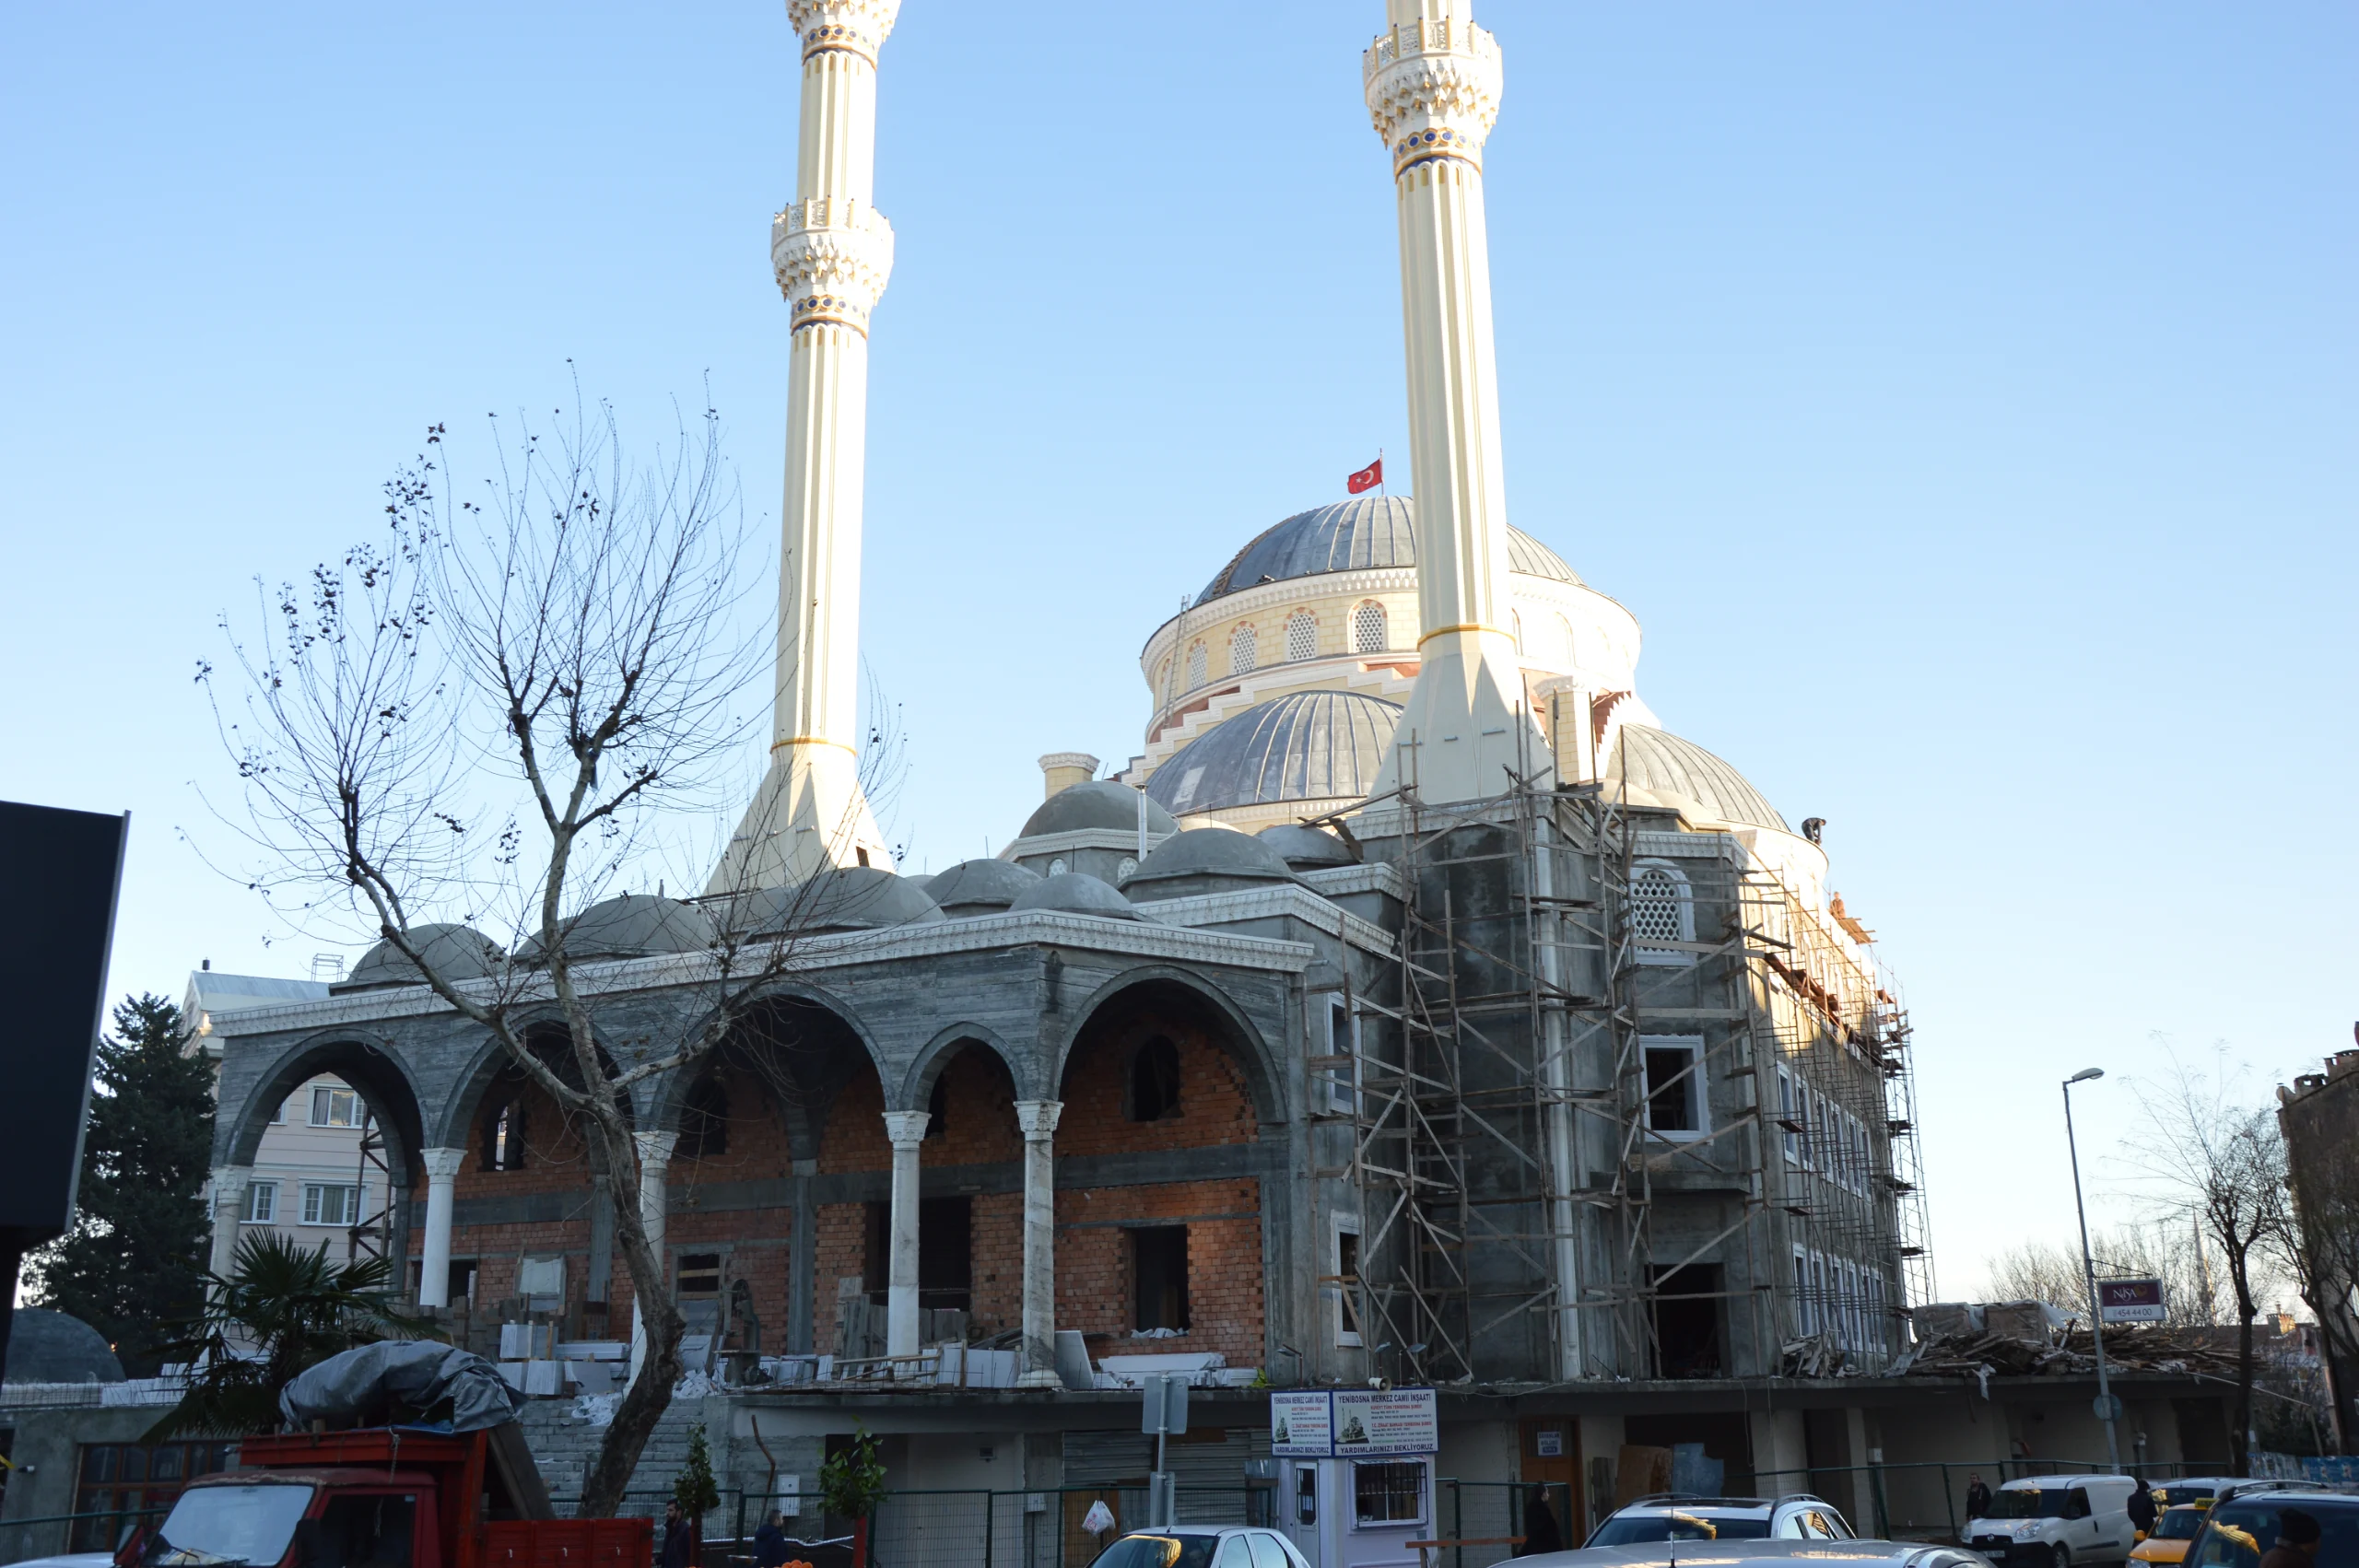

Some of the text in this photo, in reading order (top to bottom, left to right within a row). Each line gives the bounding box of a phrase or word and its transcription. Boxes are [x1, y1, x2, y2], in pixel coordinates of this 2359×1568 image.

[1338, 1393, 1369, 1403] YENİBOSNA
[1371, 1394, 1392, 1403] MERKEZ
[1411, 1392, 1431, 1403] İNŞAATI
[1340, 1443, 1433, 1454] YARDIMLARINIZI BEKLİYORUZ
